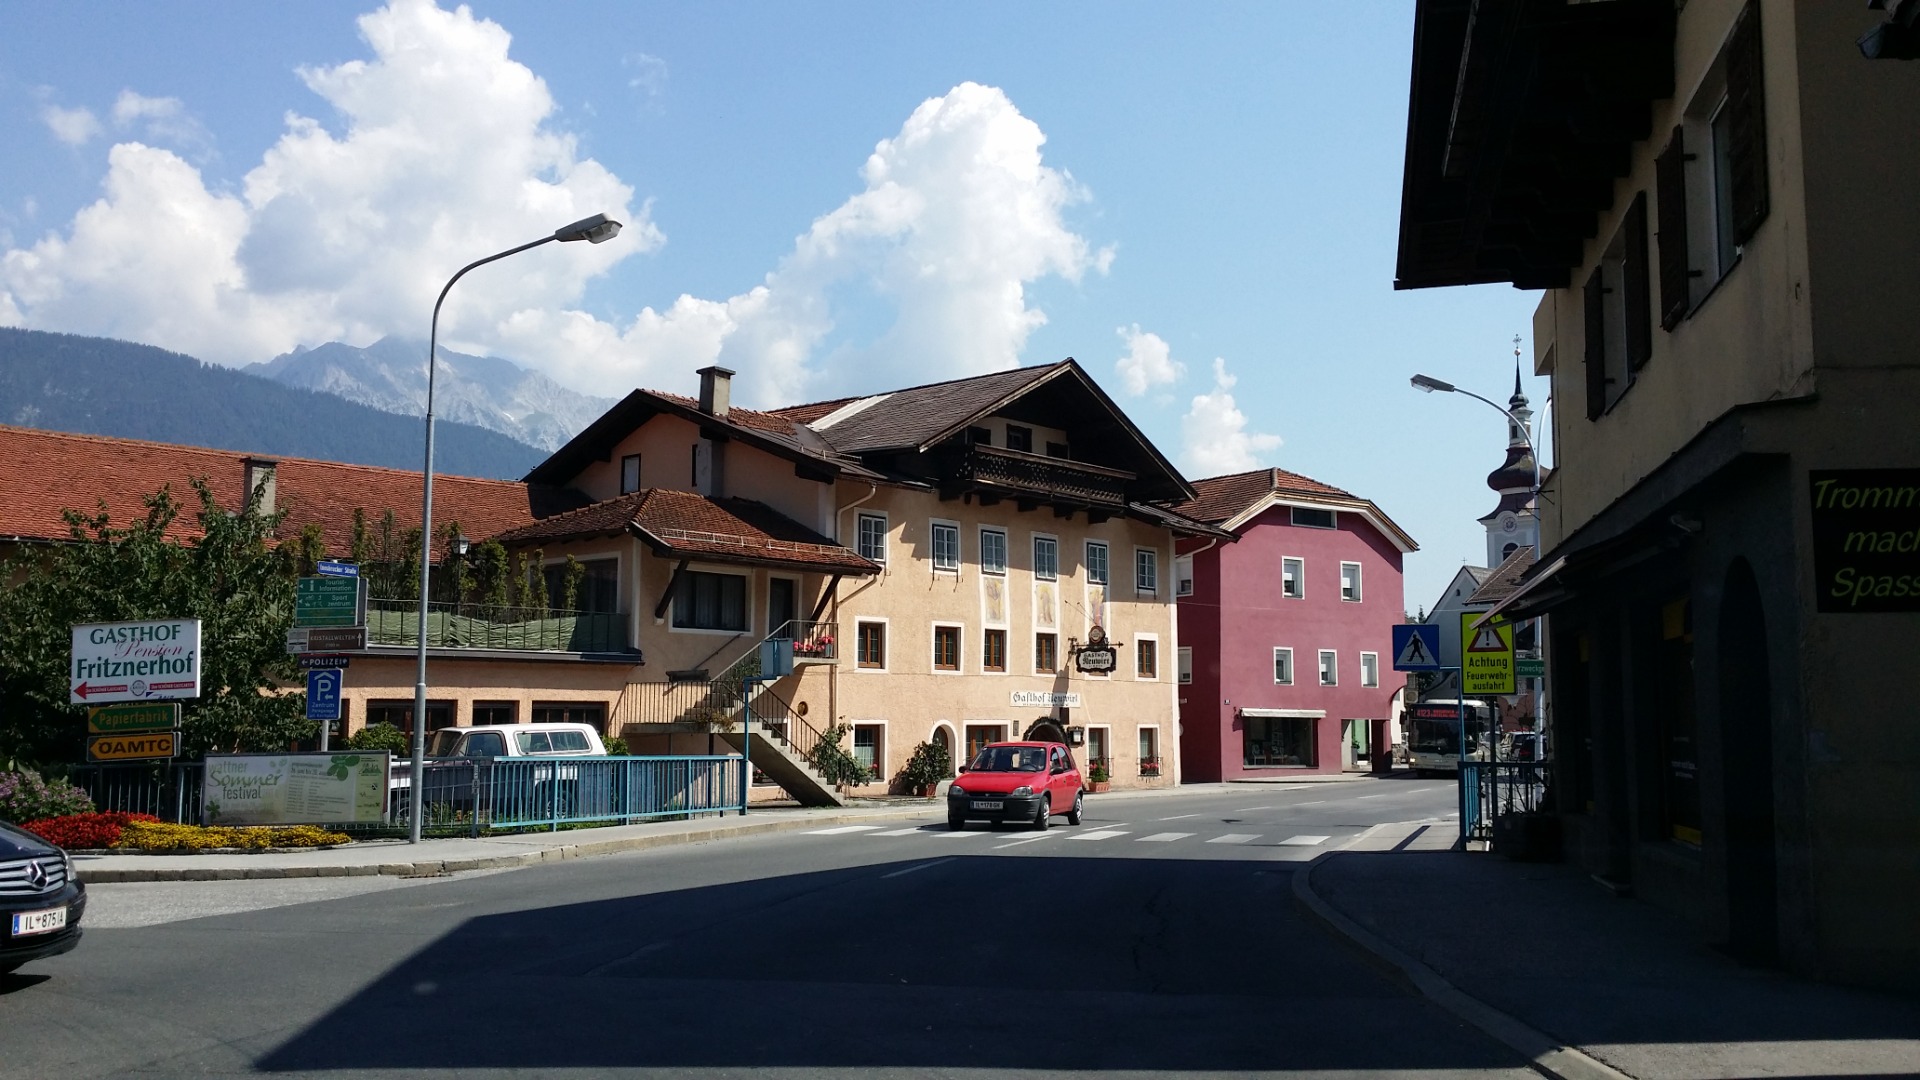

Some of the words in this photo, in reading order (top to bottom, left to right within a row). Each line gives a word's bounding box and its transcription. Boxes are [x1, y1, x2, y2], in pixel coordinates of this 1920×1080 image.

[1830, 567, 1920, 607] Spass
[332, 594, 347, 602] Sport
[90, 624, 181, 645] GASTHOF
[114, 639, 183, 659] Pension
[76, 651, 194, 679] Fritznerhof
[309, 658, 342, 666] POLIZEI
[1468, 656, 1508, 669] Achtung
[1466, 671, 1512, 680] Feuerwehr-
[316, 679, 332, 701] P
[1472, 681, 1505, 690] ausfahrt
[1012, 691, 1047, 703] Gasthof
[100, 710, 168, 725] Papierfabrik
[208, 761, 248, 774] wattner
[208, 770, 283, 787] Sommer
[222, 785, 262, 800] festival
